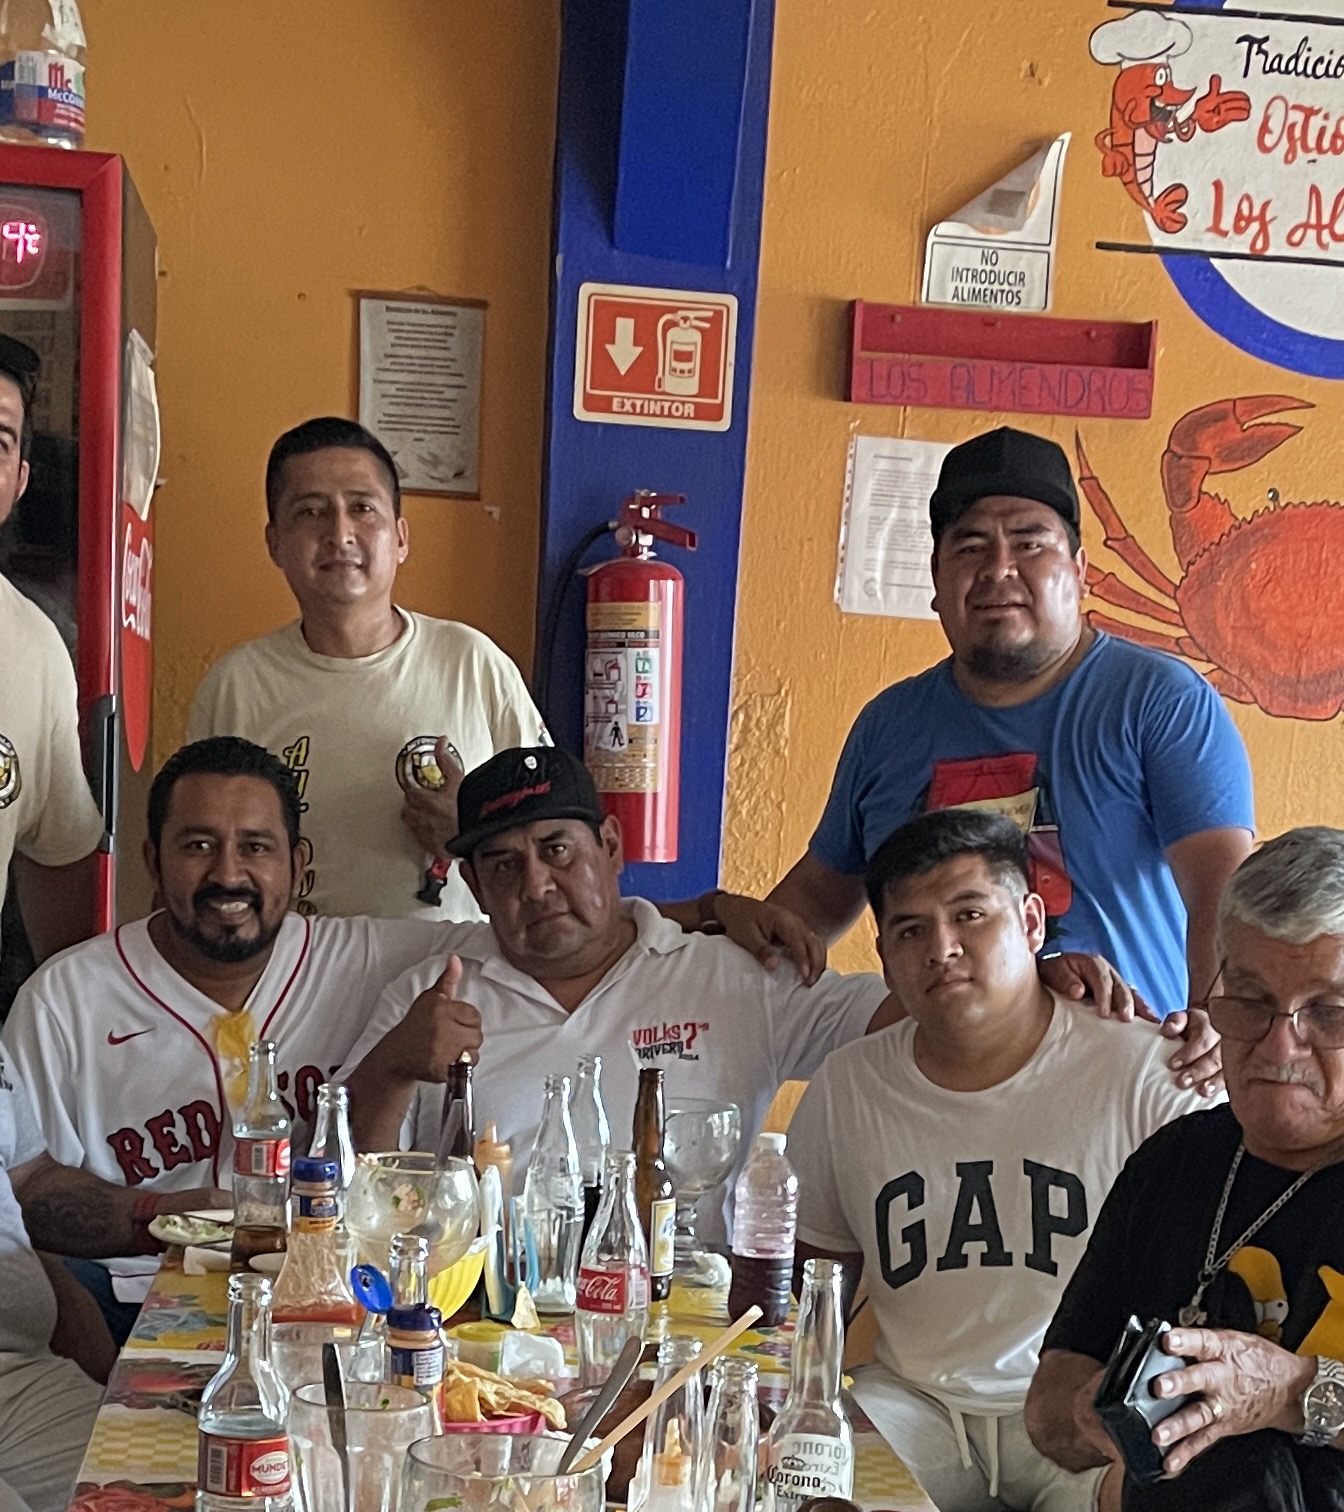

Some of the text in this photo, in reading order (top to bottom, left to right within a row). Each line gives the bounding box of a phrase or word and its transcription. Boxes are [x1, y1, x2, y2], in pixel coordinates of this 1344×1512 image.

[1204, 179, 1278, 241] Los
[980, 249, 1000, 267] NO
[951, 266, 1026, 287] INTRODUCIR
[951, 285, 1022, 305] ALIMENTOS
[868, 360, 1151, 414] LOS ALMENDROS
[610, 396, 697, 420] EXTINTOR
[107, 1099, 220, 1185] RED
[875, 1158, 1089, 1290] GAP
[767, 1465, 821, 1489] Corona
